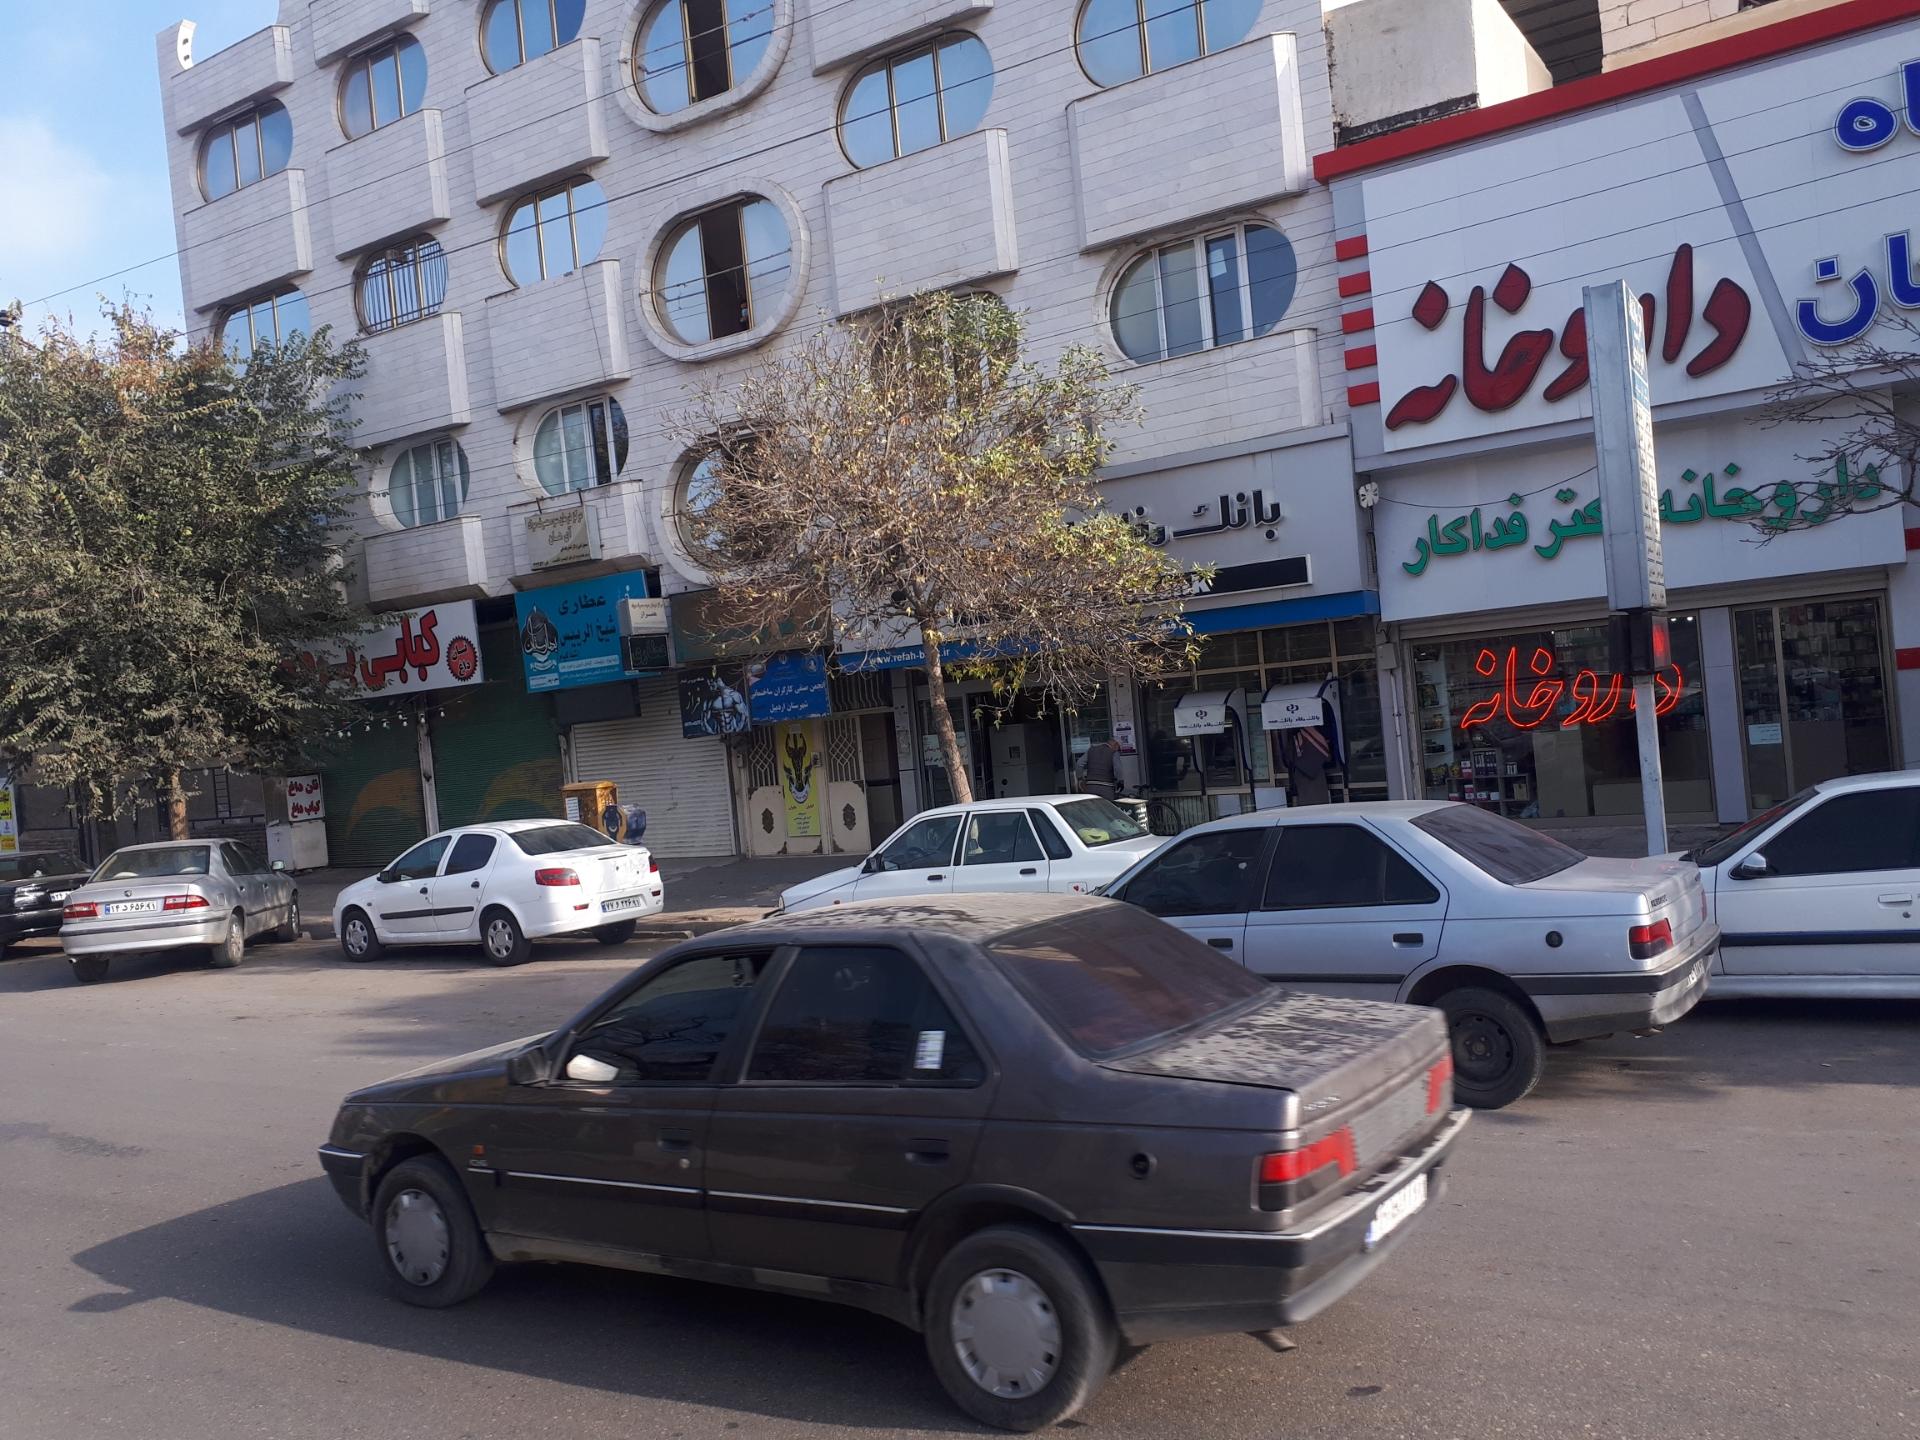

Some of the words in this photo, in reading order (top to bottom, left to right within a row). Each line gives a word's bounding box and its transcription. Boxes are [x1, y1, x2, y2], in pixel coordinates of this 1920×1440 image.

[1833, 59, 1920, 152] اه
[1796, 228, 1920, 347] ان
[1534, 488, 1604, 560] کتر
[1401, 492, 1531, 577] فداکار
[558, 593, 607, 616] عطاری
[359, 610, 441, 691] کبابی
[869, 648, 951, 665] www.refah-b.ir
[769, 703, 786, 714] اردبیل
[786, 700, 809, 712] شهرستان
[288, 781, 304, 796] داغ
[291, 802, 304, 818] داغ
[304, 800, 320, 816] کباب
[129, 902, 144, 912] ۶۵۶
